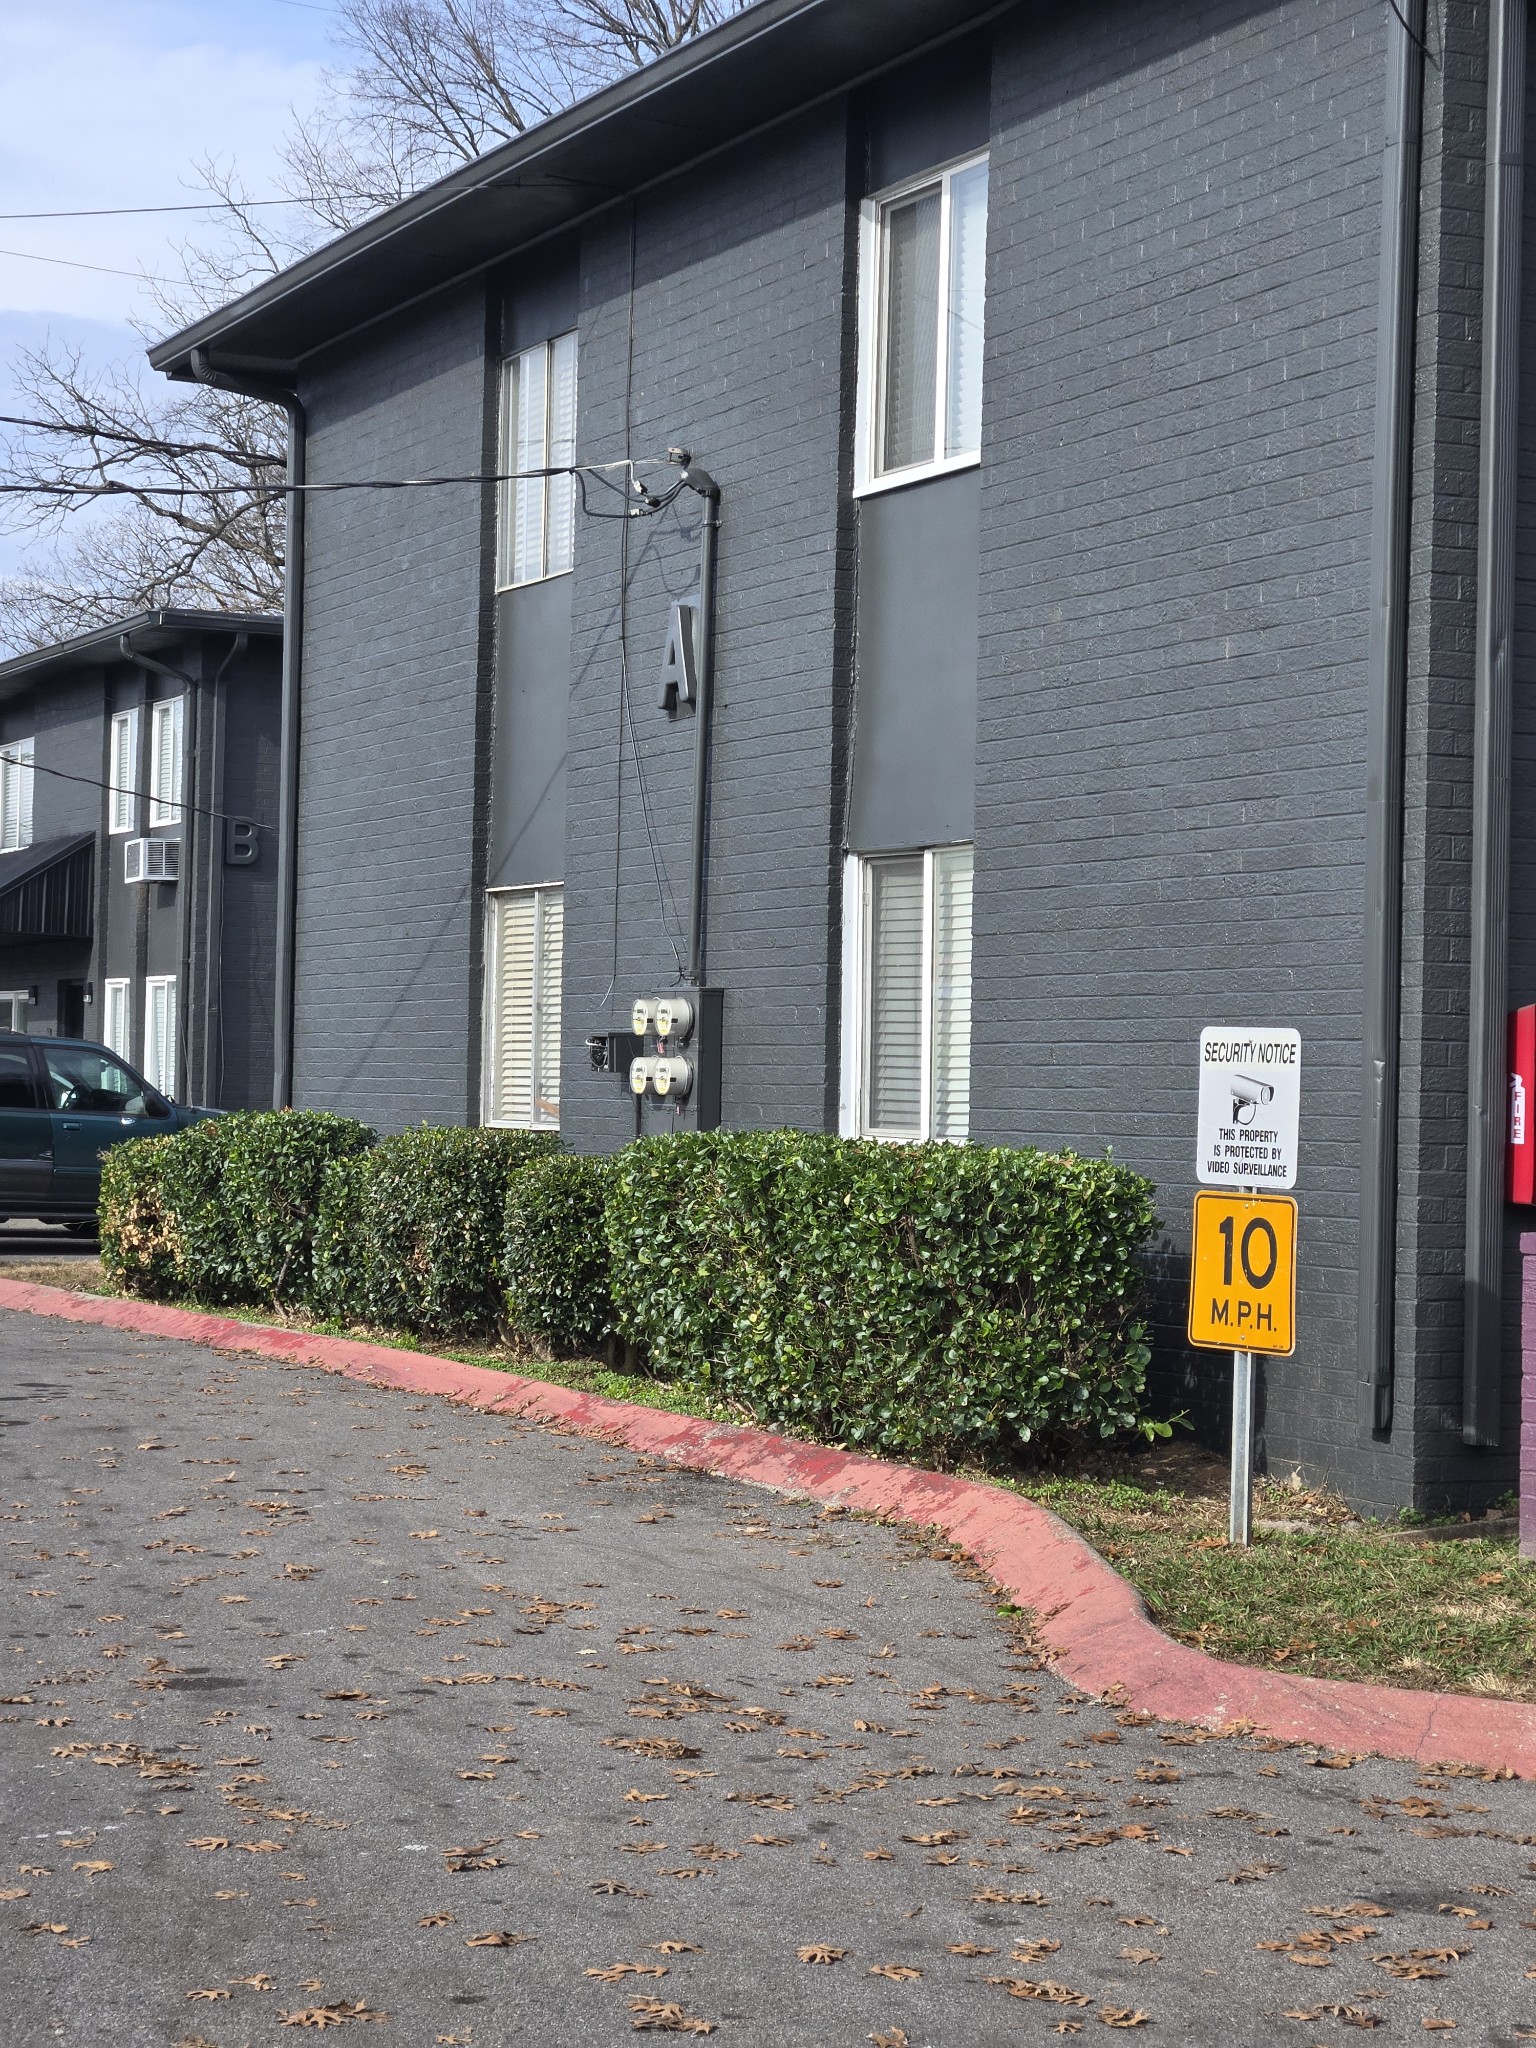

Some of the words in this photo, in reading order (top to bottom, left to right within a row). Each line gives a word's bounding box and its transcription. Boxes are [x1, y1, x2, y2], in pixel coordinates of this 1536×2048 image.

[658, 603, 697, 708] A
[227, 815, 259, 864] B
[1204, 1041, 1256, 1063] SECURITY
[1258, 1043, 1297, 1064] NOTICE
[1513, 1091, 1522, 1139] FIRE
[1213, 1144, 1221, 1157] IS
[1224, 1145, 1268, 1160] PROTECTED
[1271, 1147, 1282, 1160] BY
[1219, 1128, 1236, 1141] THIS
[1239, 1129, 1278, 1143] PROPERTY
[1207, 1160, 1230, 1174] VIDEO
[1233, 1161, 1287, 1177] SURVEILLANCE
[1219, 1215, 1278, 1290] 10
[1211, 1297, 1277, 1333] M.P.H.
